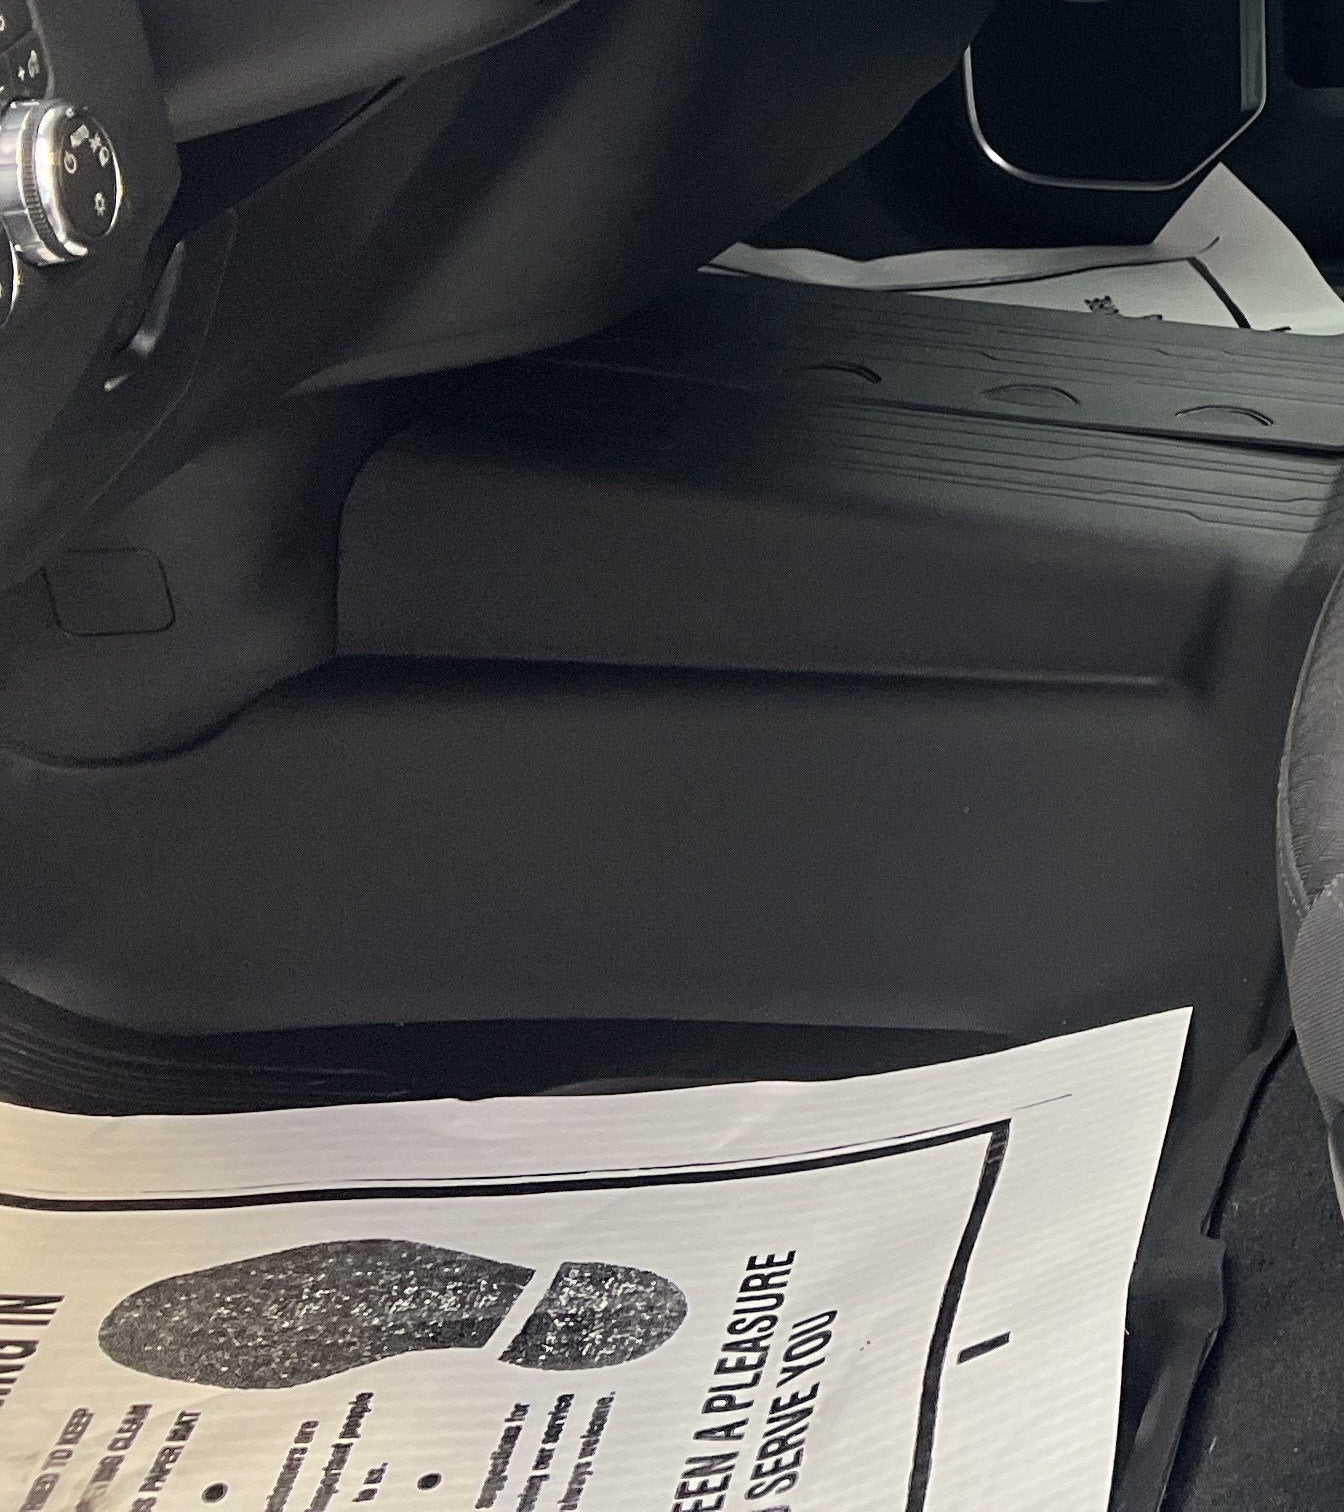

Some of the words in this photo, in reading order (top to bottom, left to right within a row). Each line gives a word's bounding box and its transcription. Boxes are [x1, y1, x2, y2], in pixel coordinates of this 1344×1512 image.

[701, 1249, 797, 1415] PLEASURE
[775, 1309, 838, 1389] YOU
[55, 1407, 95, 1446] KEEP
[107, 1404, 153, 1452] CLEAN
[294, 1420, 320, 1444] are
[338, 1391, 375, 1439] people
[541, 1393, 575, 1445] service
[578, 1390, 616, 1460] welcome.
[692, 1418, 750, 1441] A
[41, 1448, 74, 1471] TO
[138, 1444, 186, 1492] PAPER
[165, 1410, 202, 1442] MAT
[475, 1425, 523, 1510] suggestions
[504, 1402, 531, 1423] for
[532, 1447, 556, 1471] our
[744, 1380, 821, 1501] SERVE
